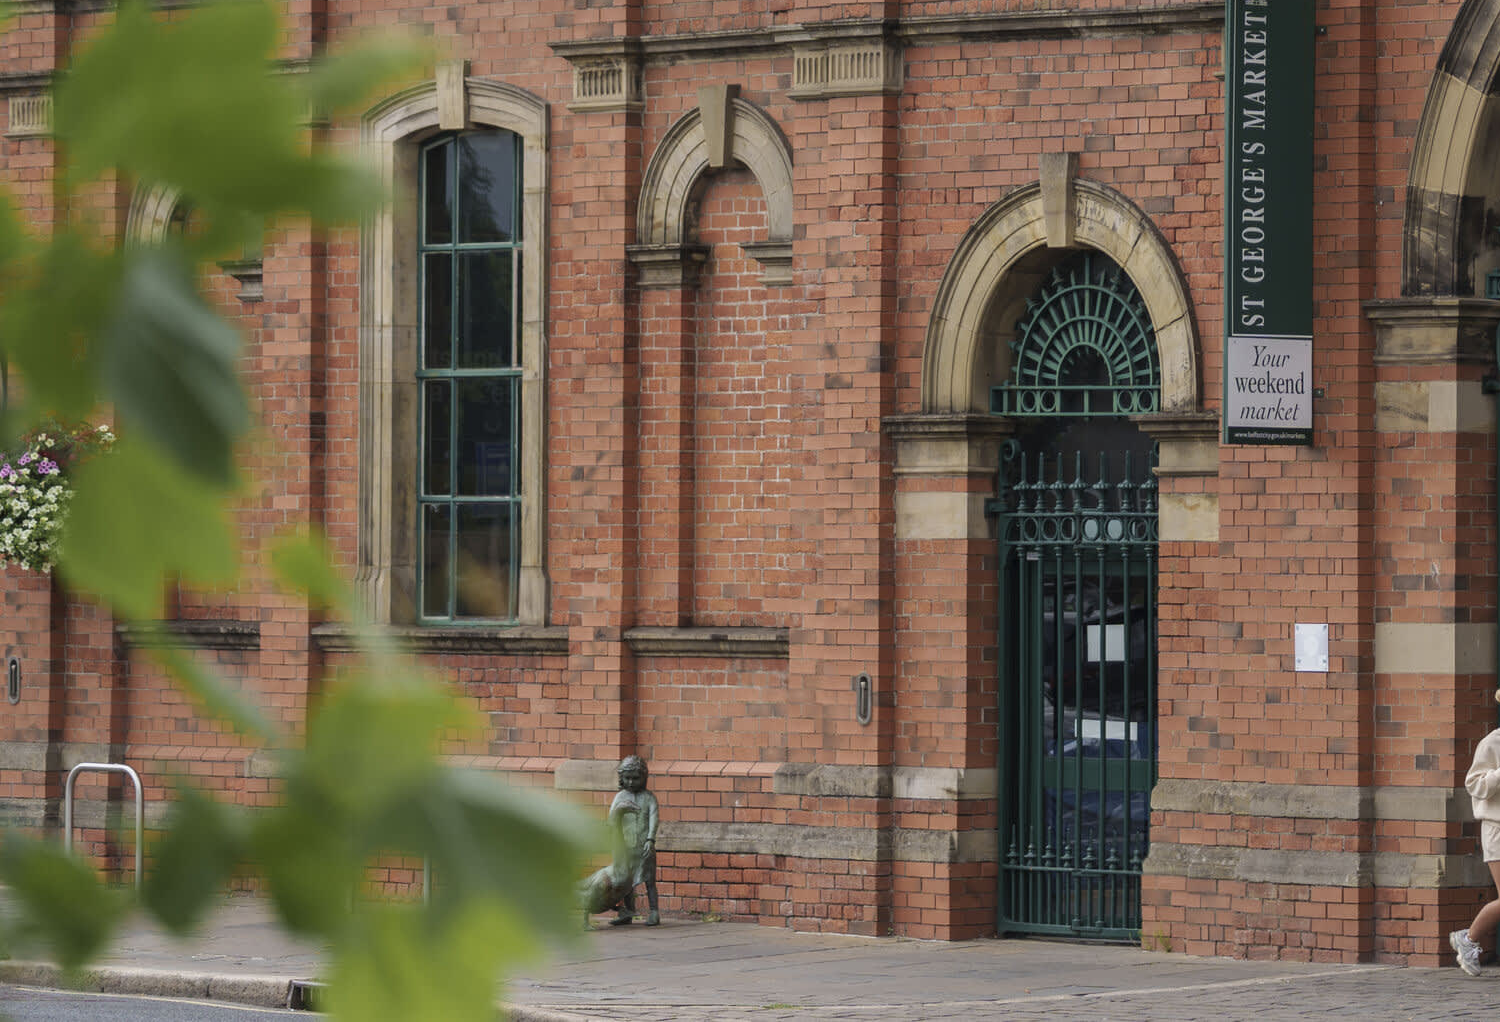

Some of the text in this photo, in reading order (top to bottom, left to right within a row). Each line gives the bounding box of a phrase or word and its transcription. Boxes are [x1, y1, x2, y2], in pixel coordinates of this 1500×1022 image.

[1242, 11, 1268, 327] ST GEORGE'S MARKET
[1252, 345, 1290, 368] Your
[1234, 370, 1305, 395] weekend
[1240, 397, 1300, 421] market
